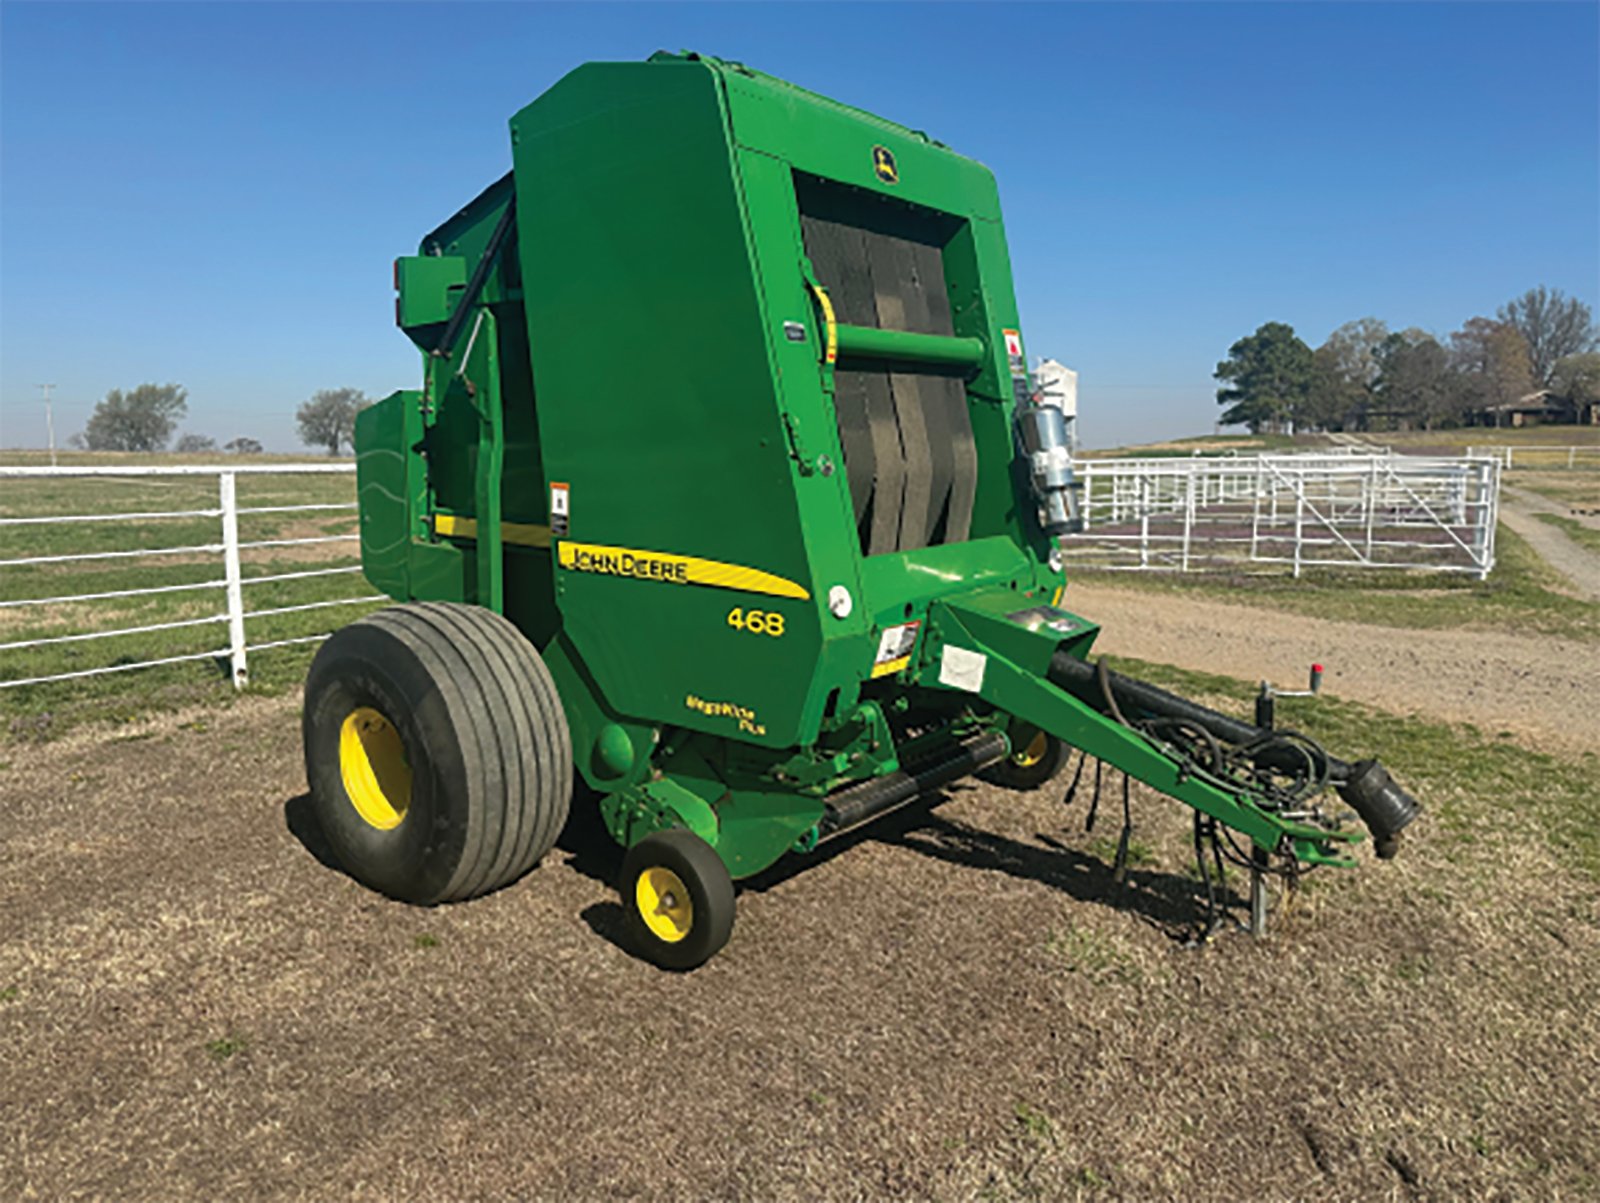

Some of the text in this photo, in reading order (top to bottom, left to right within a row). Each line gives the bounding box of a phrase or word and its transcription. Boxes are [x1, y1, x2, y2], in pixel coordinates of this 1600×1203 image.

[571, 548, 688, 582] JOHN DEERE
[727, 607, 786, 637] 468
